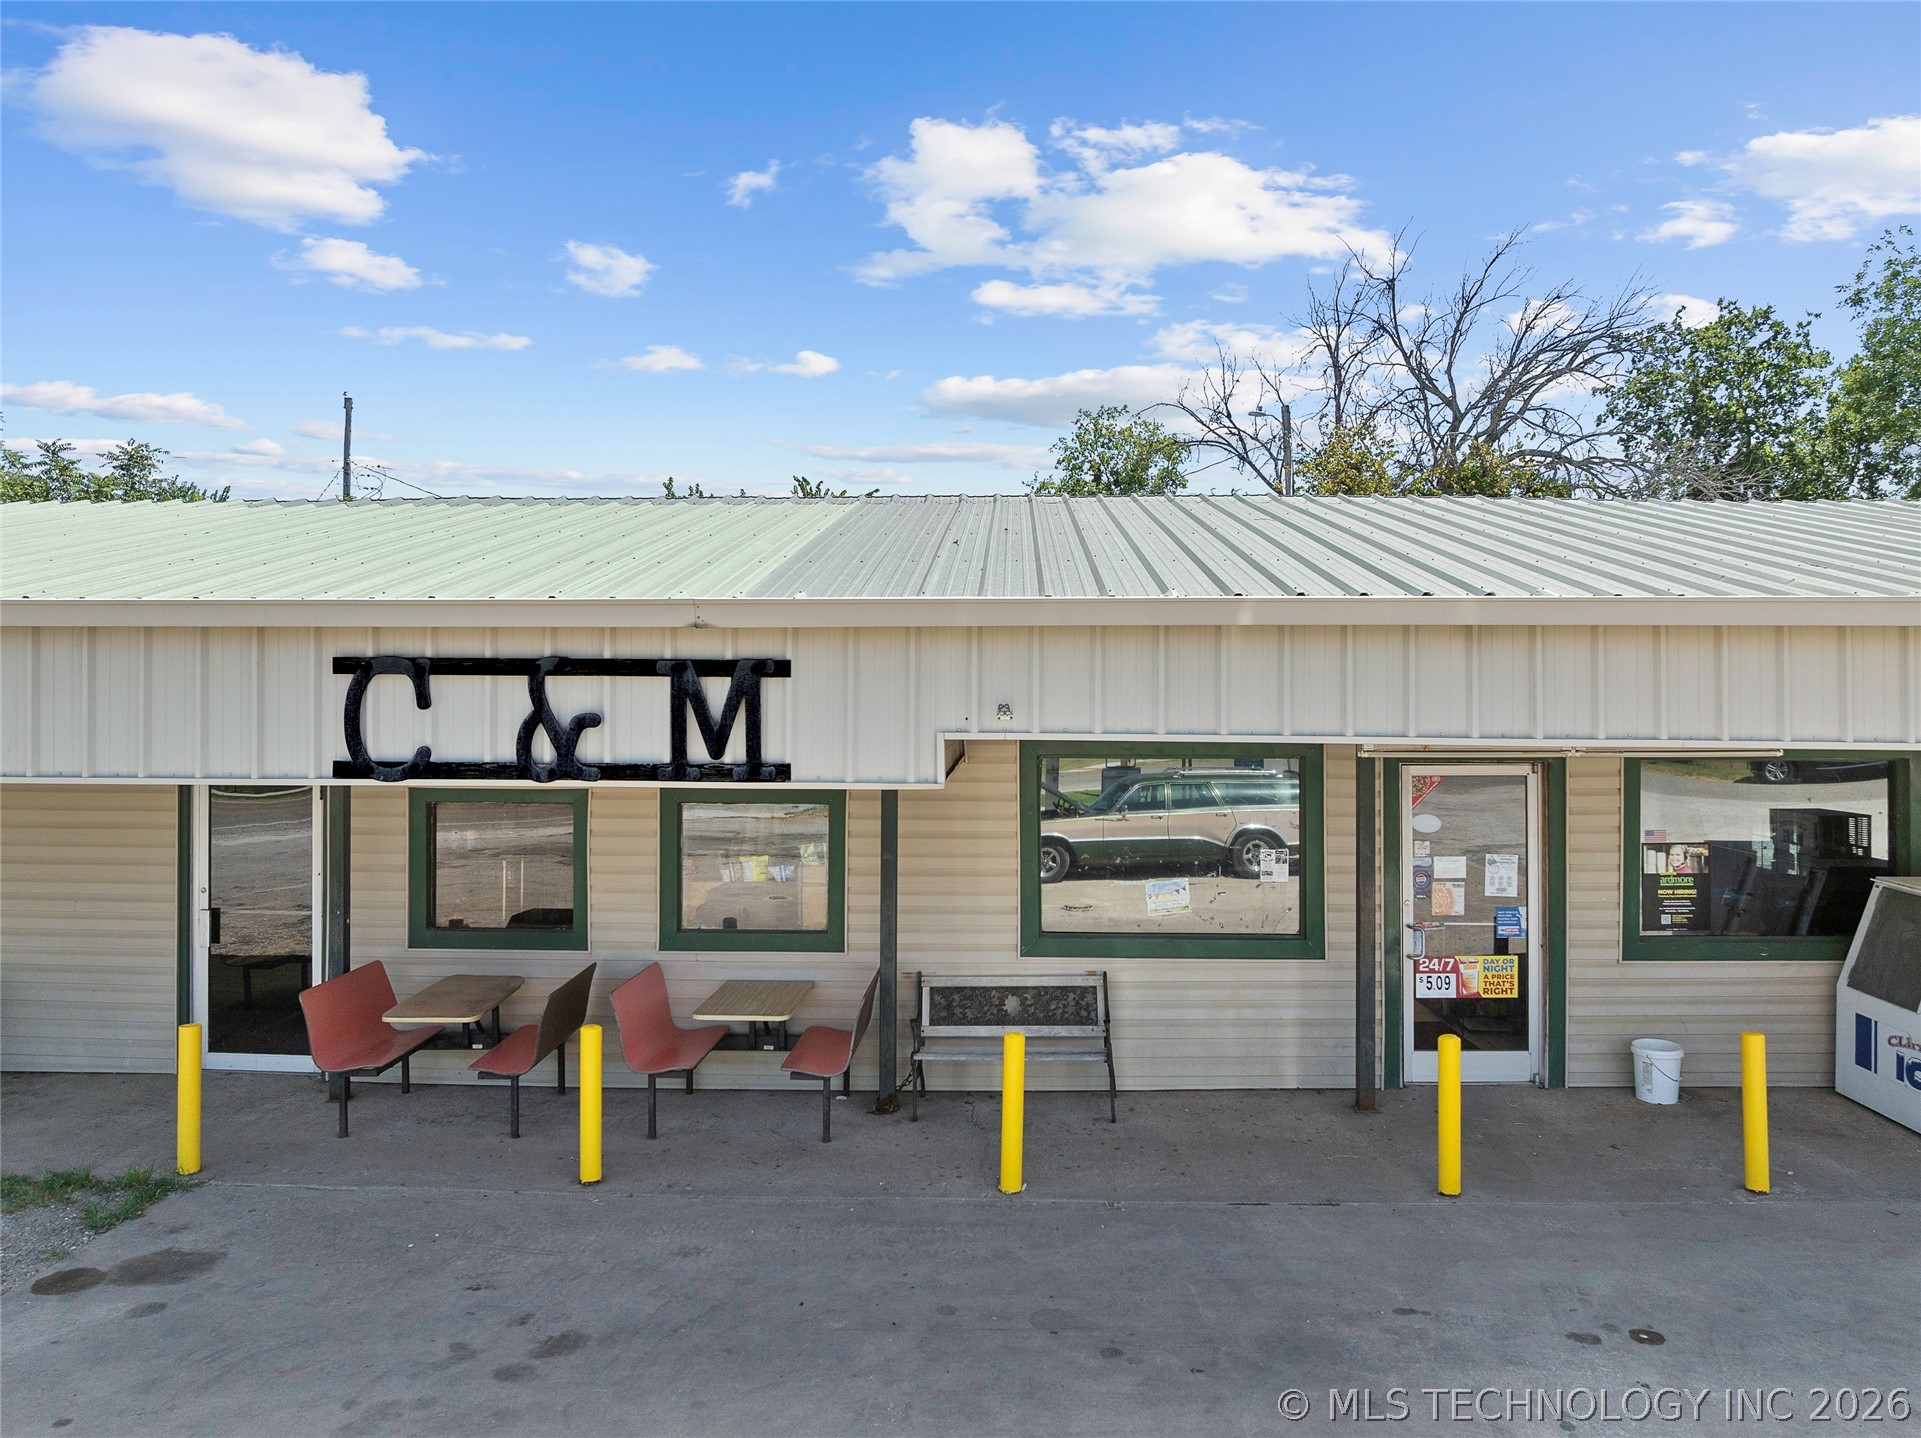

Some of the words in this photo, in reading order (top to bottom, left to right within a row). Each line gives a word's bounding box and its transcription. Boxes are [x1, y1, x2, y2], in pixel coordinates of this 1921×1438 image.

[344, 656, 432, 782] C
[516, 656, 602, 783] &
[656, 659, 776, 782] M
[1660, 875, 1694, 884] ardmore
[1419, 958, 1455, 972] 24/7
[1483, 965, 1515, 973] NIGHT
[1483, 987, 1515, 995] RIGHT
